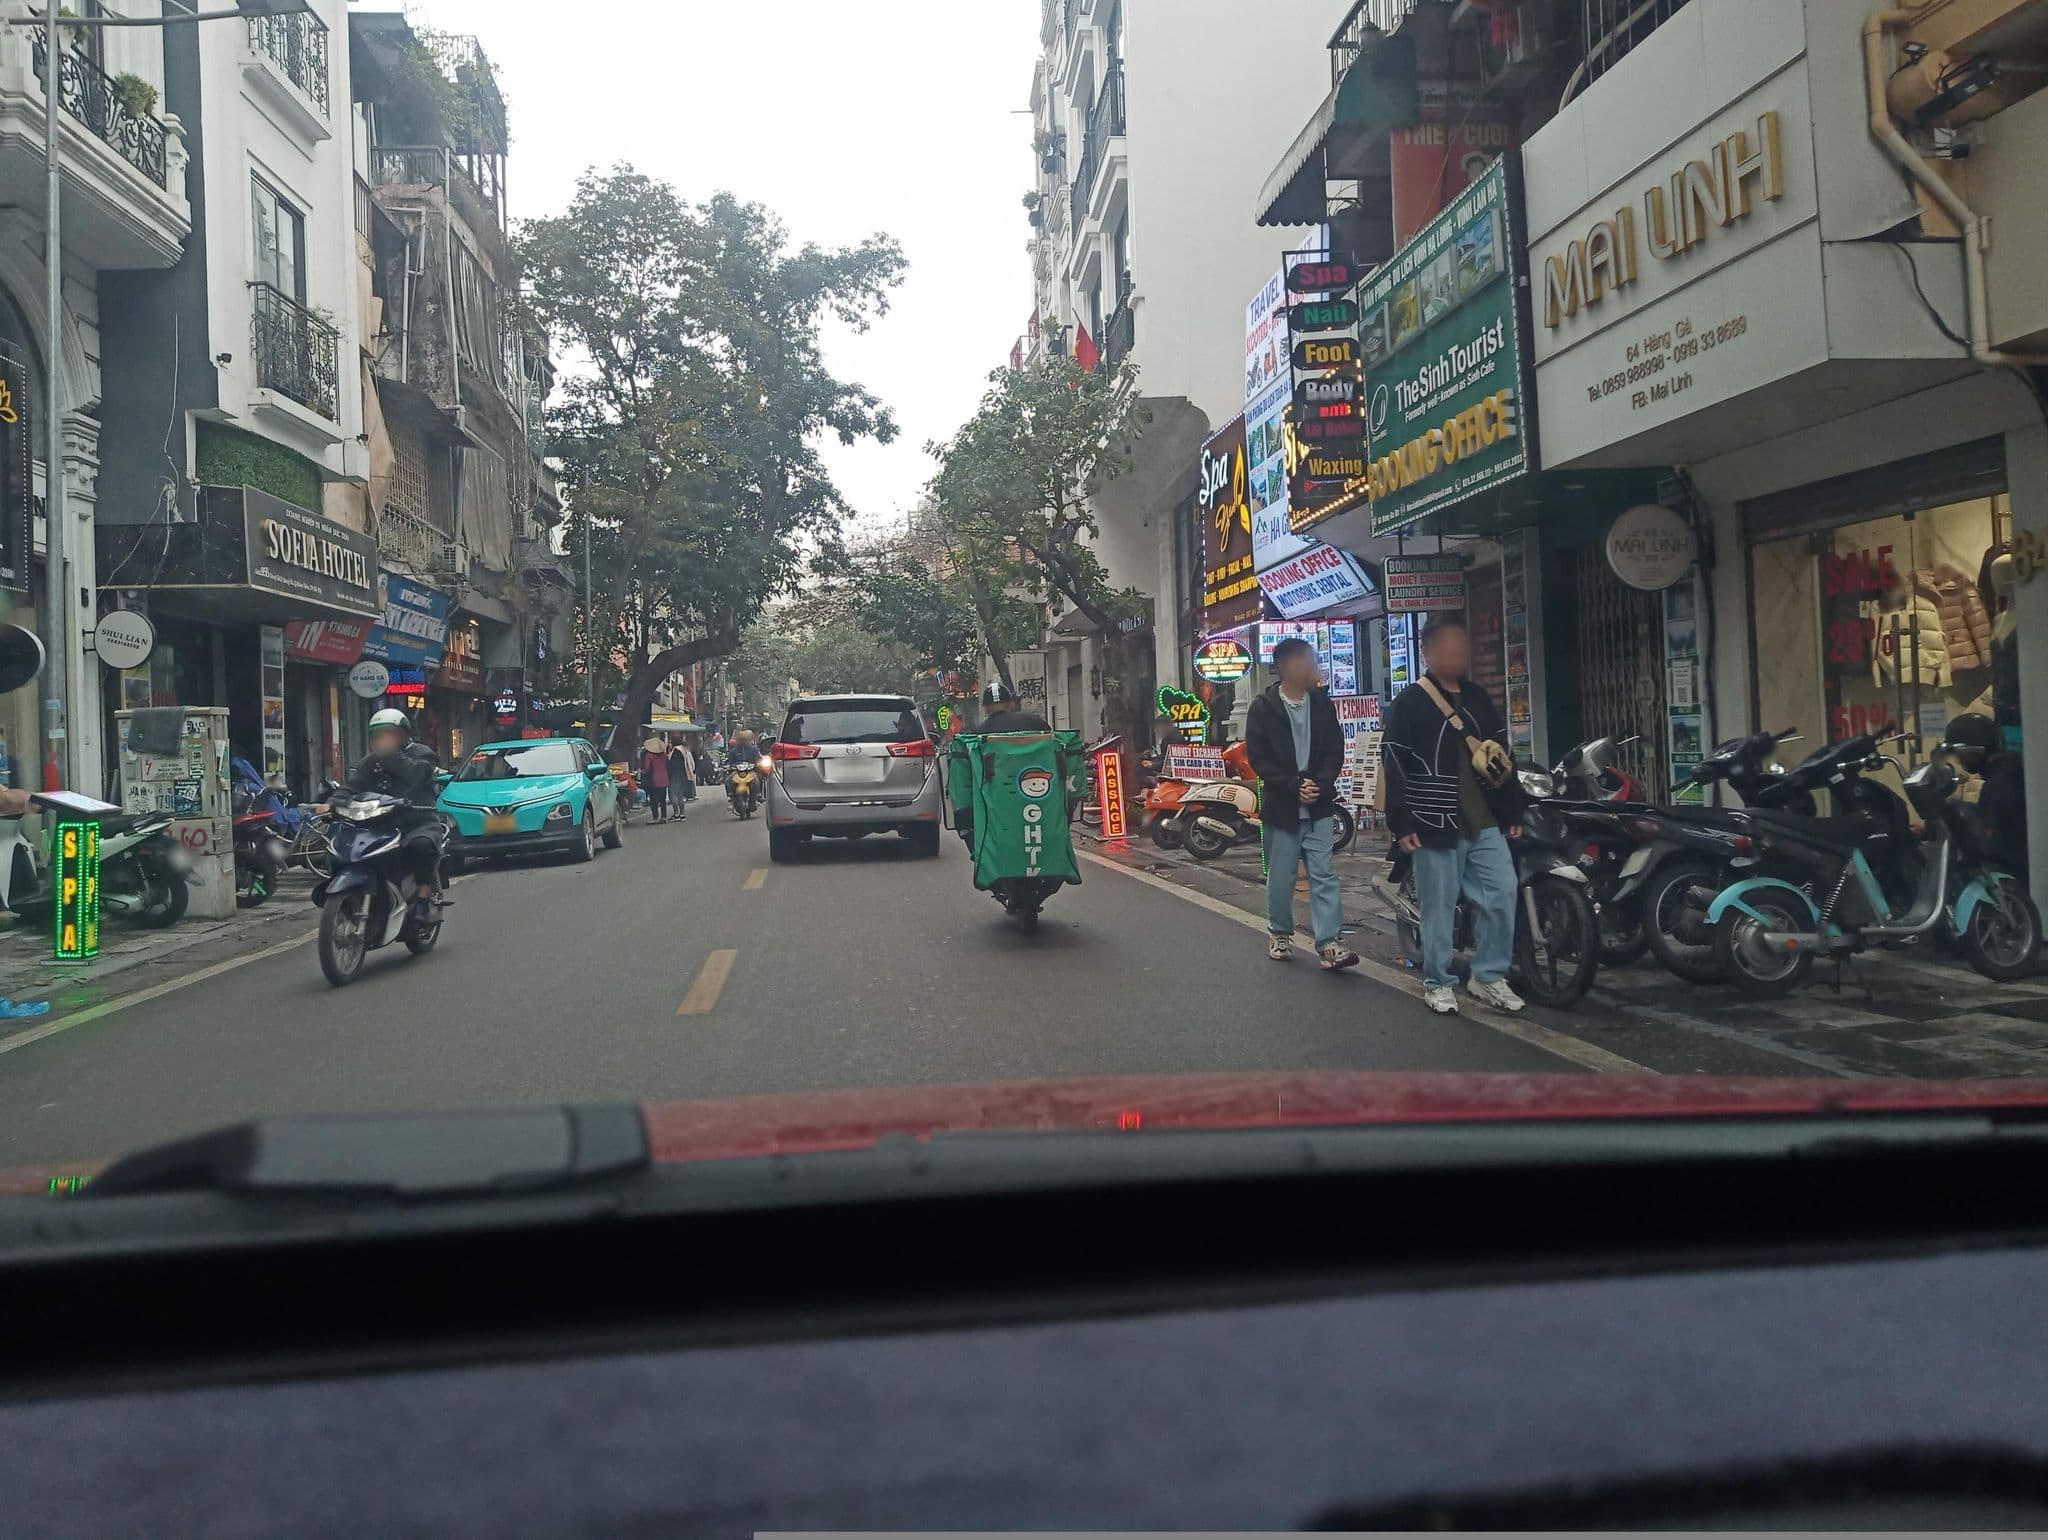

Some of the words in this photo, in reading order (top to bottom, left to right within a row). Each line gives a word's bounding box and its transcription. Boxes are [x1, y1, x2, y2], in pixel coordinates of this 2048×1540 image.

[1545, 206, 1637, 328] MAI
[1644, 111, 1783, 260] LINH
[1301, 264, 1348, 286] Spa
[1250, 274, 1280, 326] TRAVEL
[1303, 303, 1348, 325] Nail
[1305, 342, 1351, 364] Foot
[1602, 372, 1626, 396] 0859
[1627, 353, 1665, 385] 988998
[1673, 338, 1698, 363] 0919
[1701, 330, 1715, 351] 33
[1626, 342, 1639, 363] 64
[1305, 380, 1355, 401] Body
[1631, 390, 1648, 410] FB:
[1651, 380, 1670, 403] Mai
[1671, 371, 1692, 394] Linh
[1368, 428, 1443, 502] BOOKING
[1443, 388, 1517, 465] OFFICE
[1308, 458, 1363, 477] Waxing
[1200, 448, 1229, 510] Spa
[266, 518, 320, 573] SOFIA
[322, 539, 370, 590] HOTEL
[1614, 539, 1645, 553] MAI
[1653, 538, 1689, 553] LINH
[1260, 562, 1307, 593] BOOKING
[1301, 547, 1342, 577] OFFICE
[1389, 560, 1429, 573] BOOKING
[1826, 544, 1894, 596] SALE
[1276, 581, 1321, 609] MOTORBIKE
[1316, 571, 1353, 597] RENTAL
[1389, 575, 1418, 586] MONEY
[1390, 587, 1427, 598] LAUNDRY
[1429, 585, 1463, 597] SERVICE
[101, 629, 123, 640] SHUI
[126, 634, 149, 646] LIAN
[1259, 623, 1282, 634] MONEY
[1208, 642, 1239, 658] SPA
[1262, 636, 1275, 644] SIM
[387, 684, 426, 694] PHARMACY
[1170, 703, 1201, 720] SPA
[1343, 697, 1380, 720] EXCHANGE
[1171, 746, 1192, 758] MONEY
[1193, 747, 1223, 759] EXCHANGE
[1173, 758, 1185, 767] SIM
[1186, 759, 1202, 767] CARD
[1174, 769, 1200, 778] MOTORBIKE
[1201, 769, 1212, 778] FOR
[1212, 769, 1224, 778] RENT
[1105, 756, 1121, 833] MASSAGE
[63, 830, 77, 951] SPA
